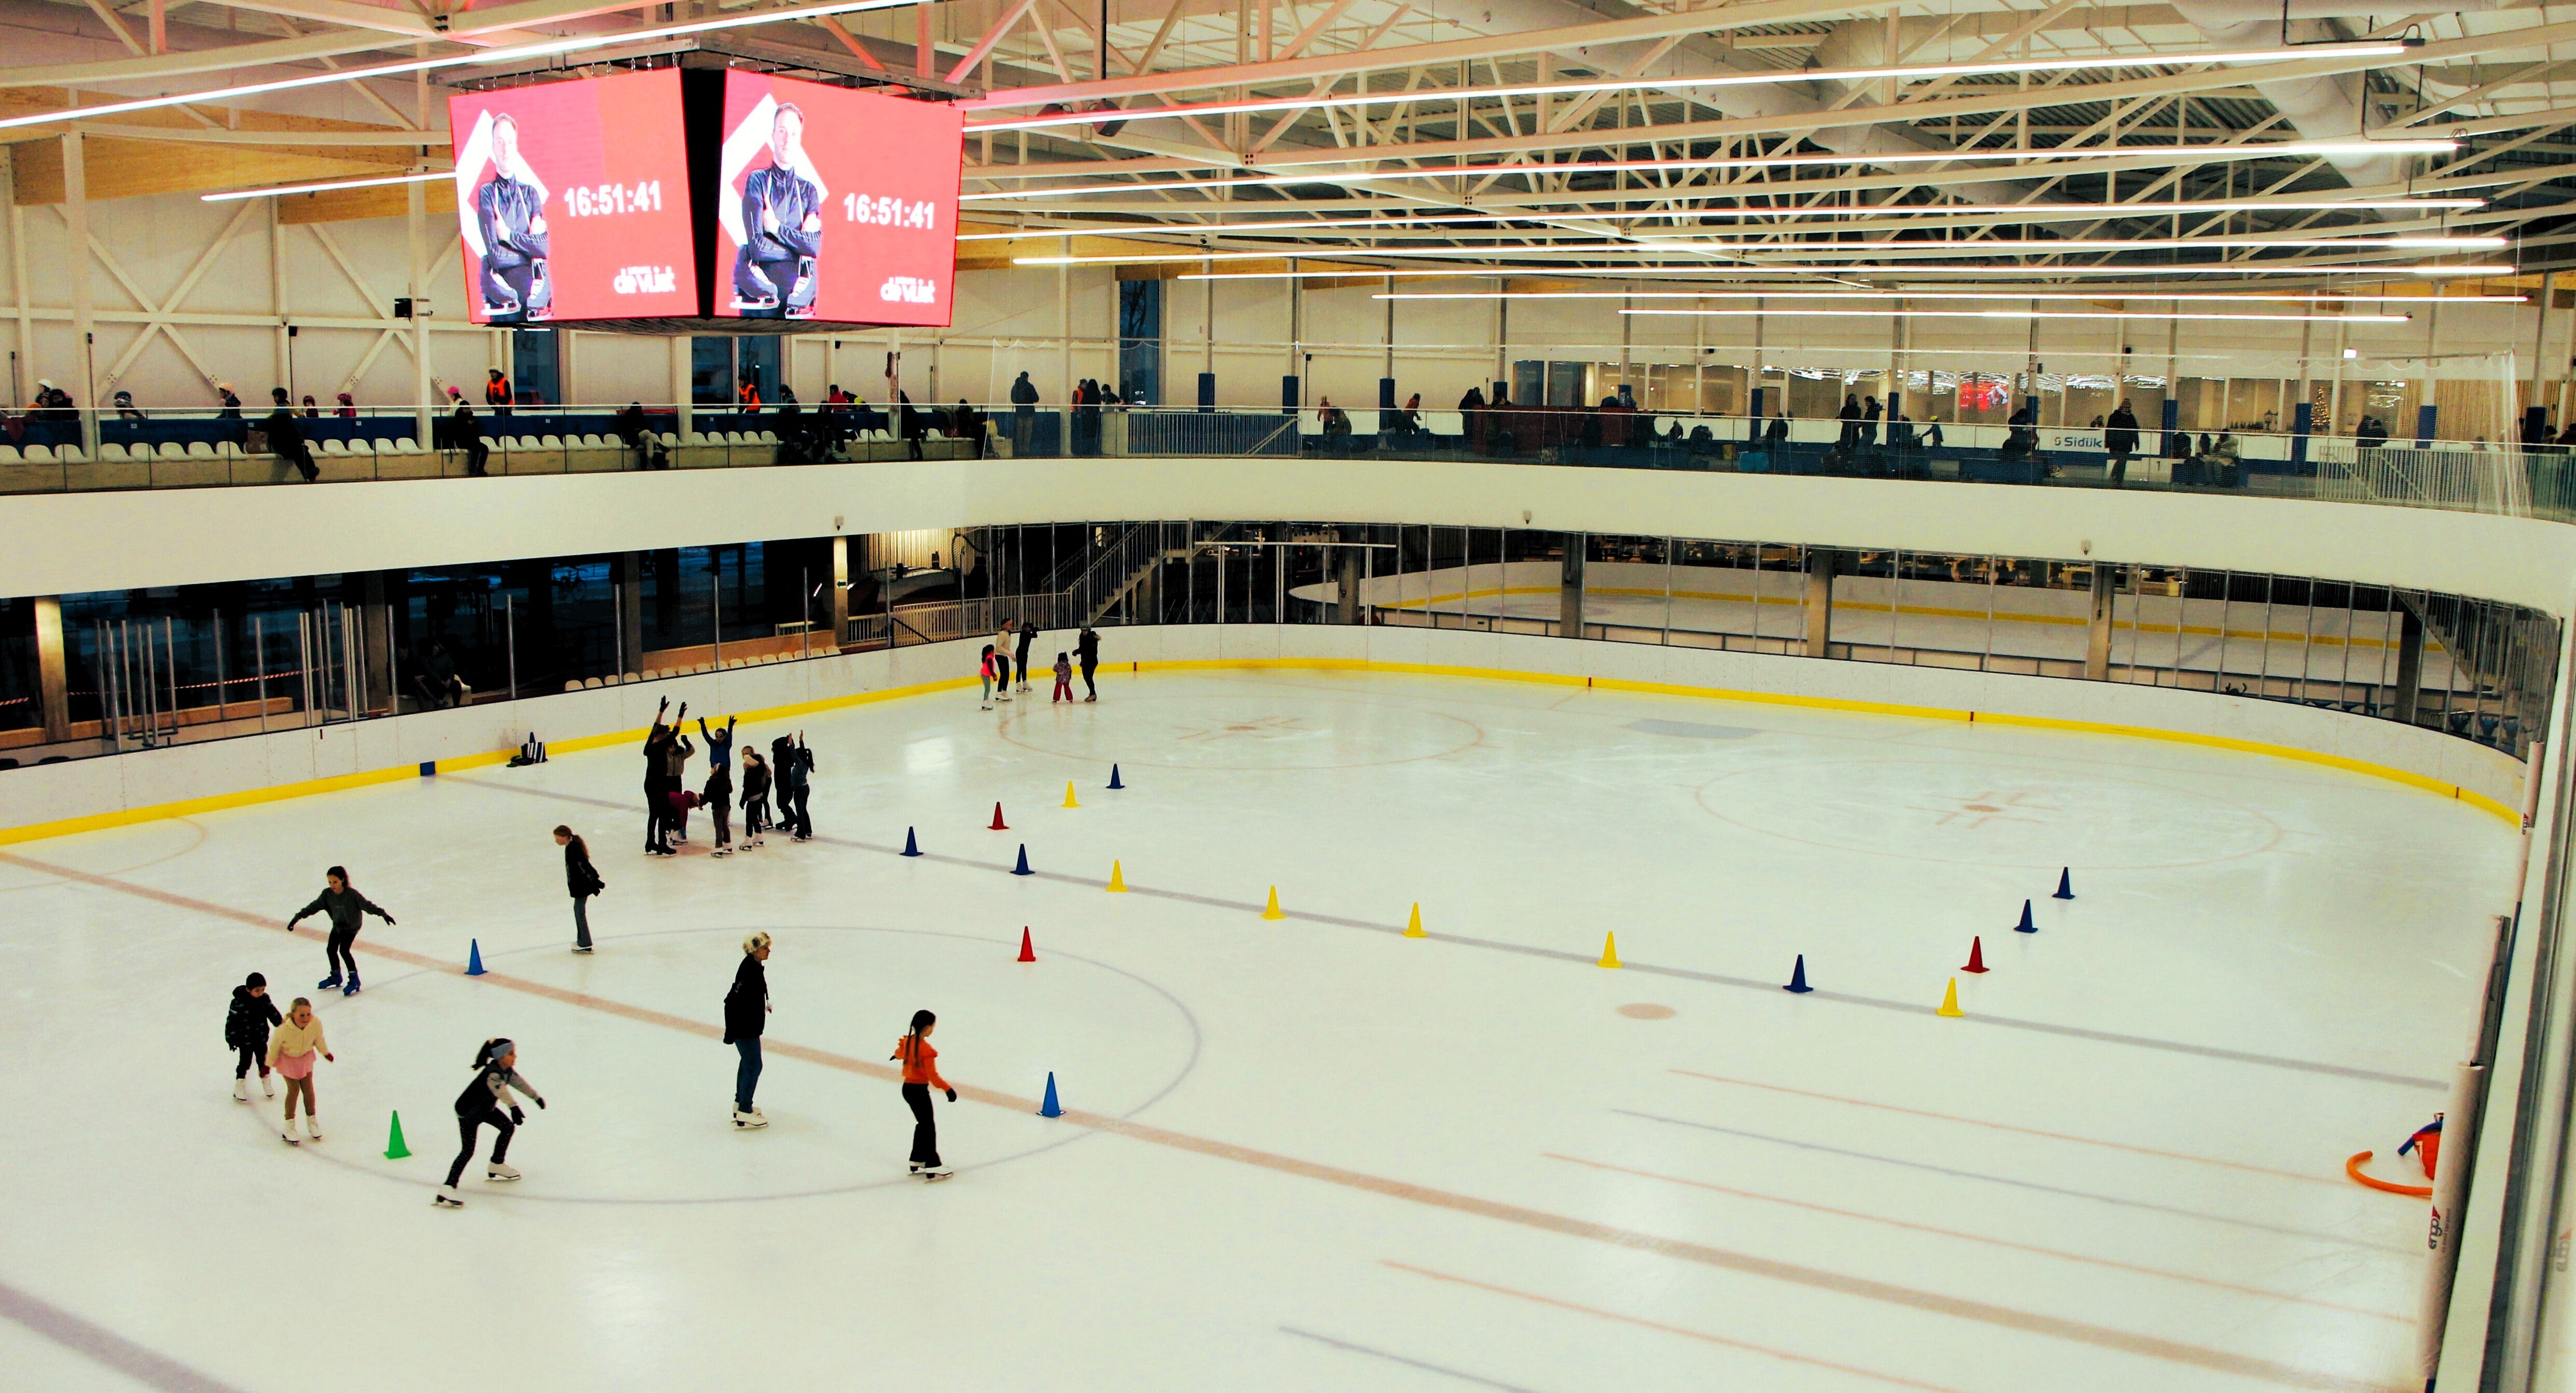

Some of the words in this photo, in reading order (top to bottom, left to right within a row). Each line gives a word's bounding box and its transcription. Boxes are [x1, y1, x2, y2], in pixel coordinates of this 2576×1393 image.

[564, 180, 661, 217] 16:51:41
[844, 193, 934, 229] 16:51:41
[2064, 436, 2102, 447] Sidijk
